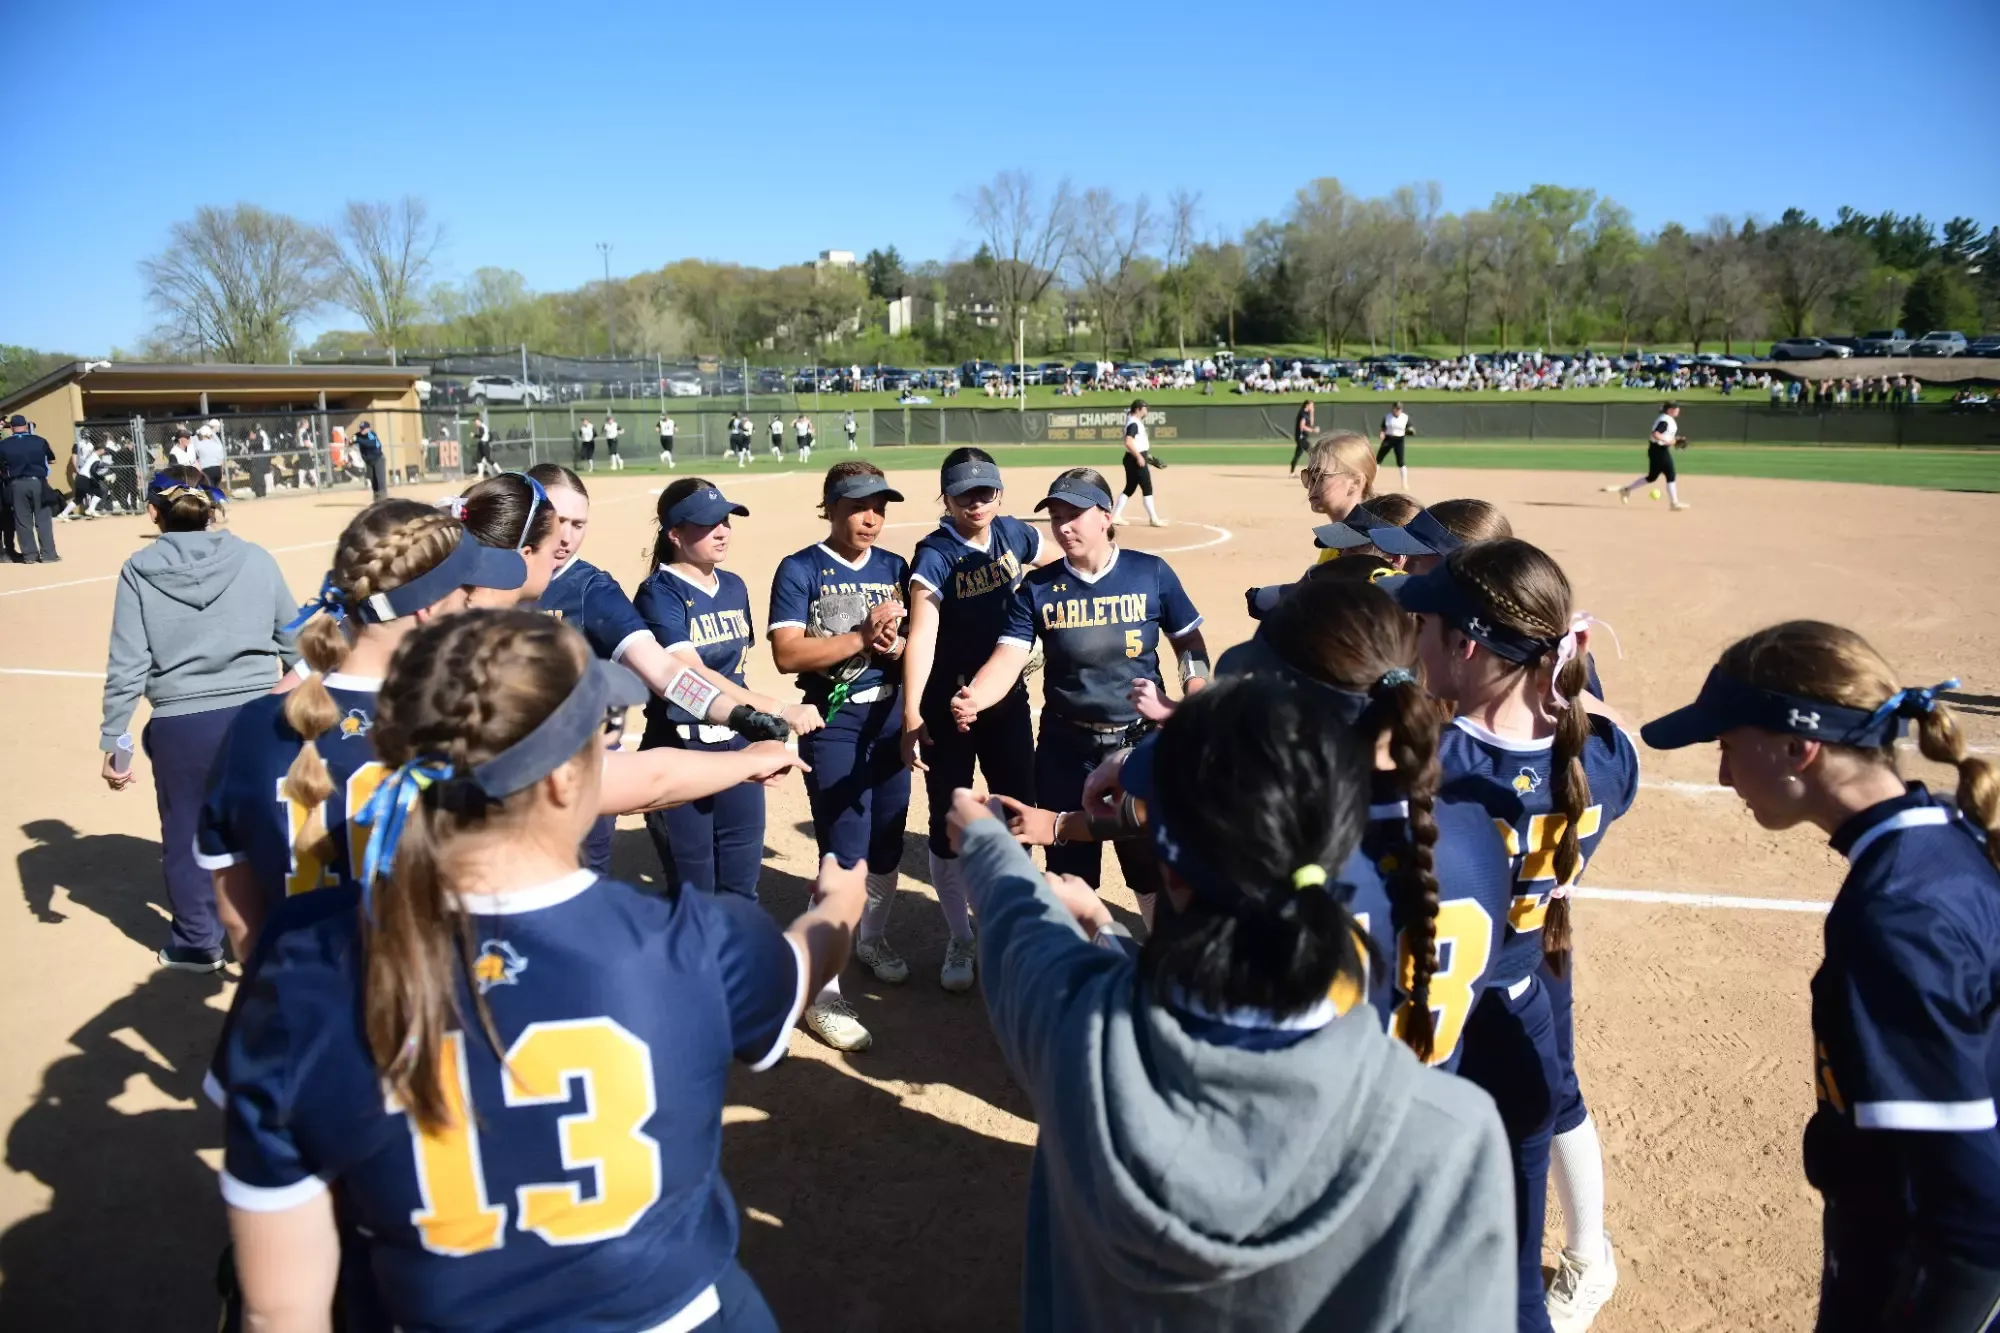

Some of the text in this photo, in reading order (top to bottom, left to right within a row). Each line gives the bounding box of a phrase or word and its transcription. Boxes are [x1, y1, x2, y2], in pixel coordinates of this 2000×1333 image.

[1079, 411, 1166, 426] CHAMPIOHIPS
[956, 549, 1020, 600] CARLETO
[1042, 593, 1148, 630] CARLETON
[1124, 629, 1144, 658] 5
[1494, 804, 1603, 934] 5
[382, 1015, 663, 1258] 13
